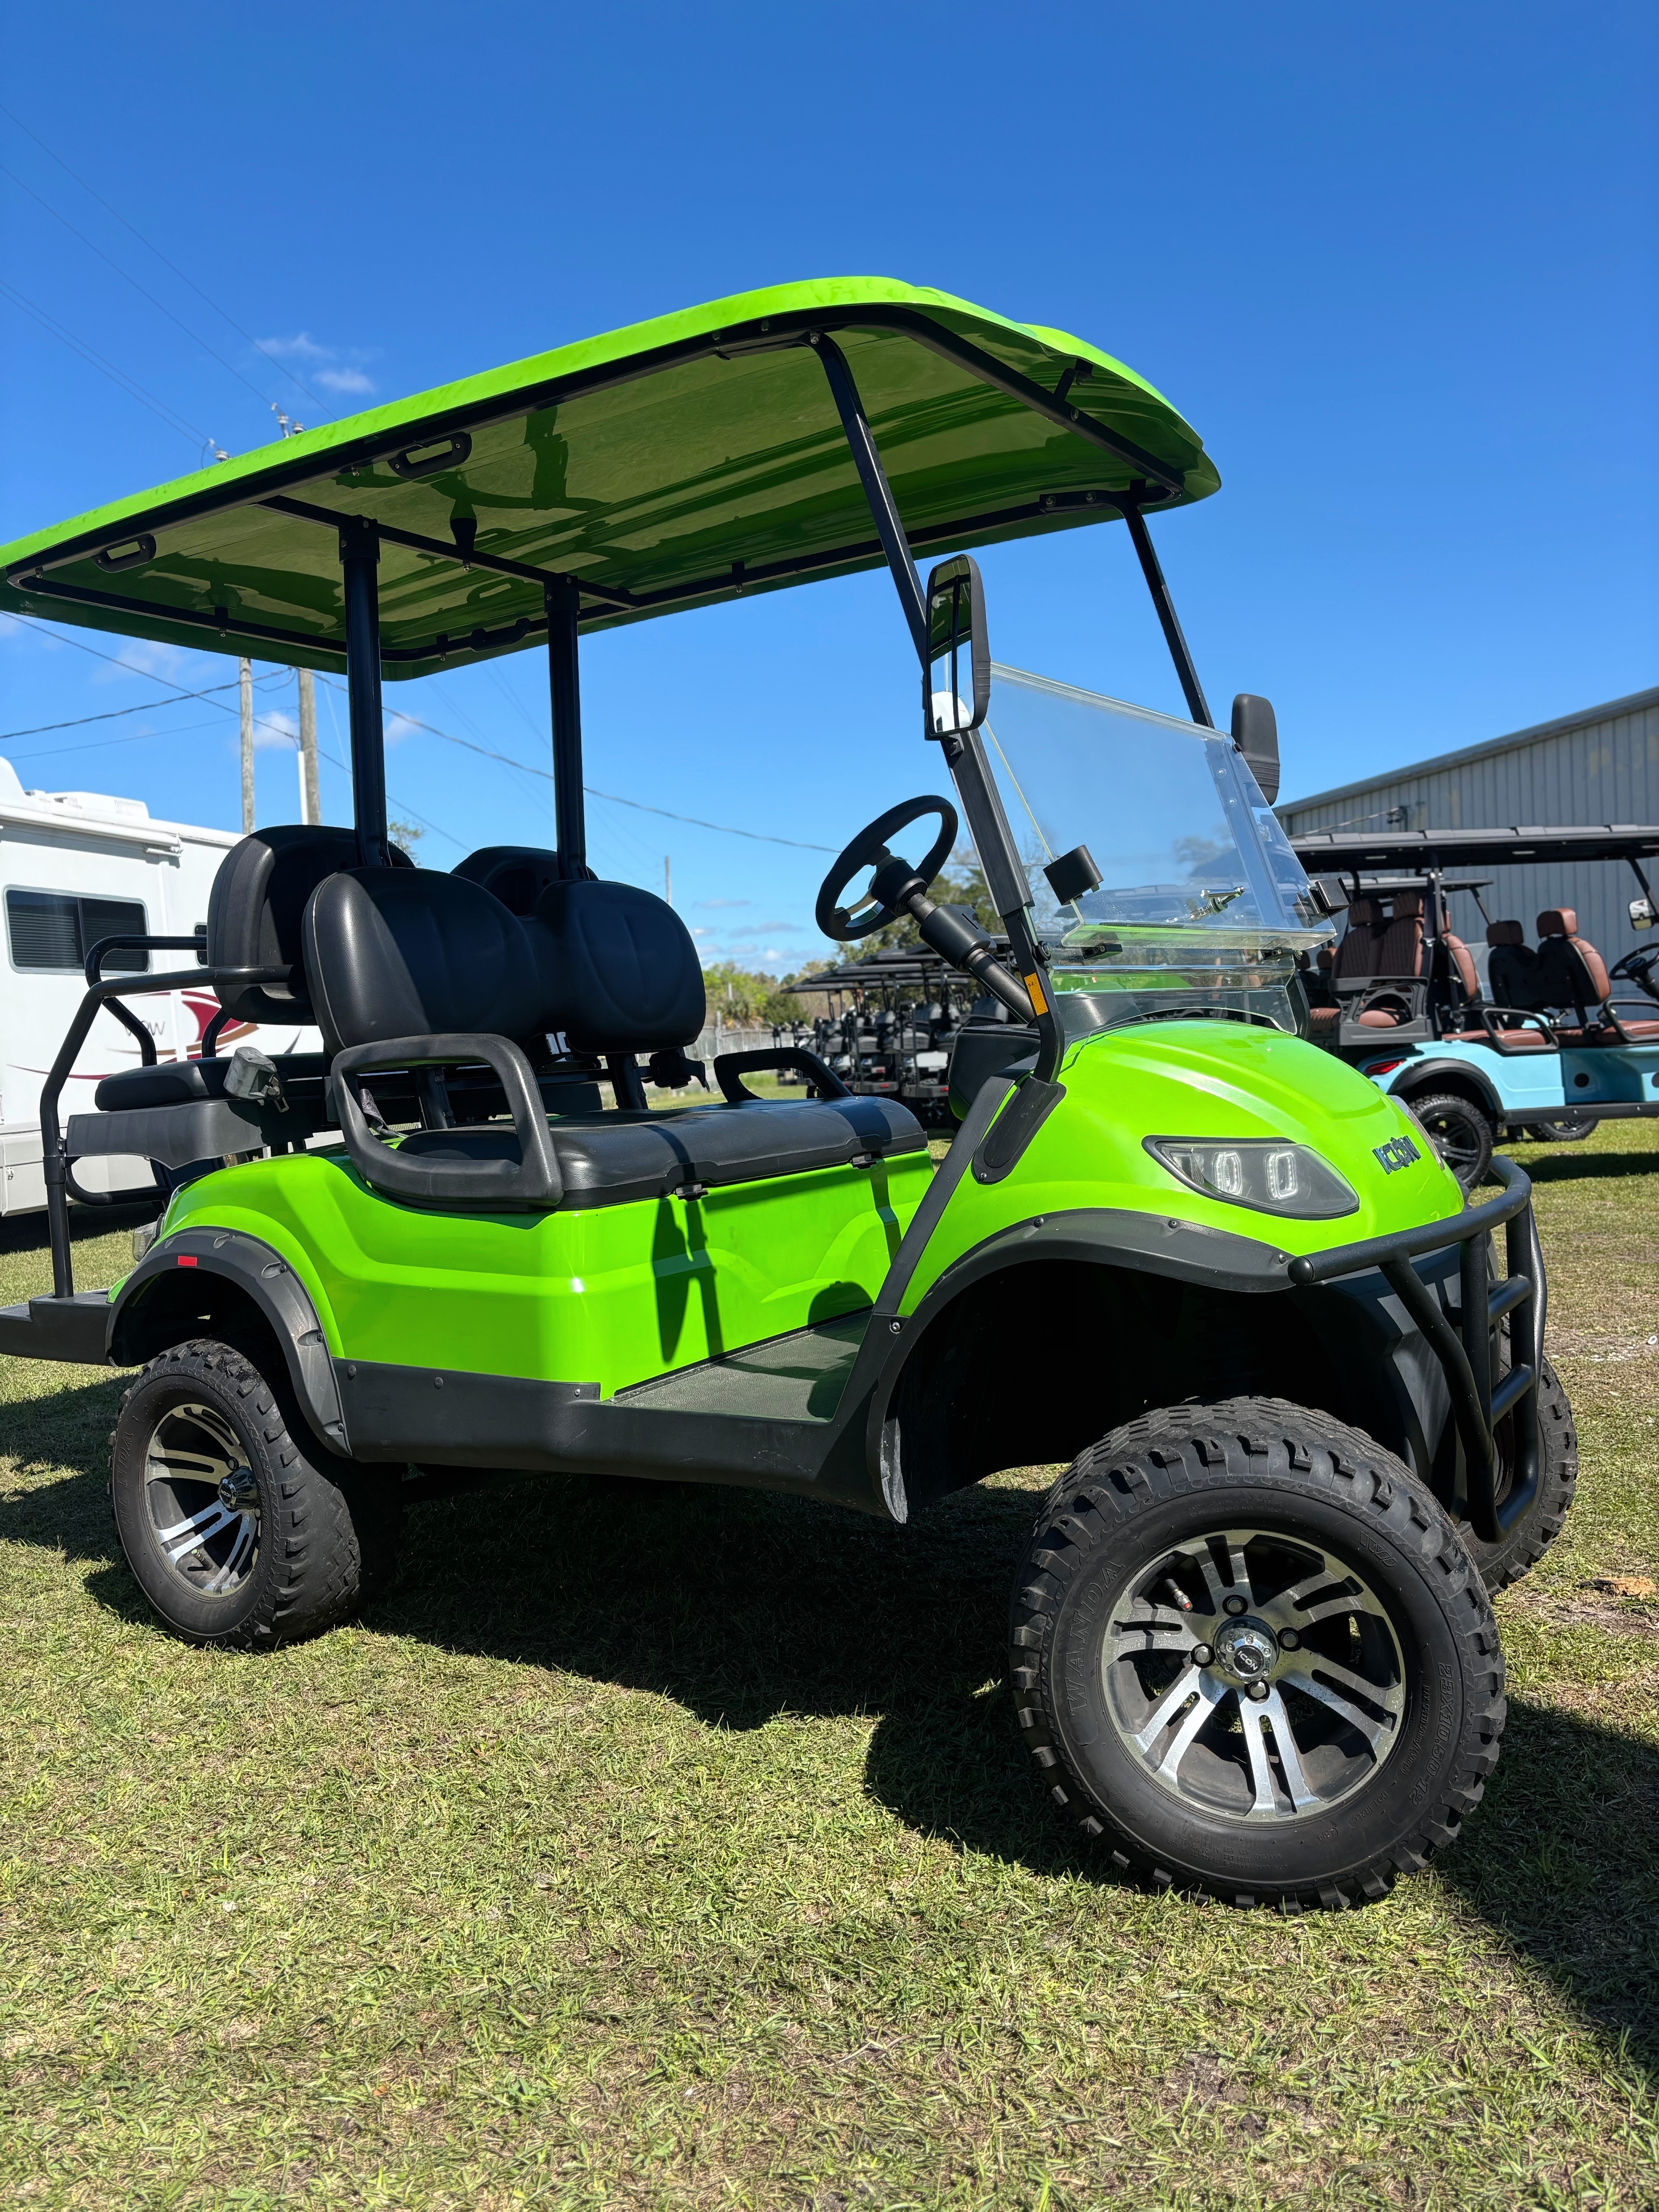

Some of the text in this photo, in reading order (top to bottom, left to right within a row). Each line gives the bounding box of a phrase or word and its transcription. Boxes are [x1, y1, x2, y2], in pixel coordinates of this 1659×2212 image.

[1372, 1135, 1422, 1175] ICON
[116, 1431, 135, 1533] WANDA
[1064, 1561, 1126, 1713] WANDA
[1237, 1650, 1258, 1671] ICON
[1408, 1662, 1454, 1807] 23X10.50-12
[1421, 1703, 1429, 1724] SPEED
